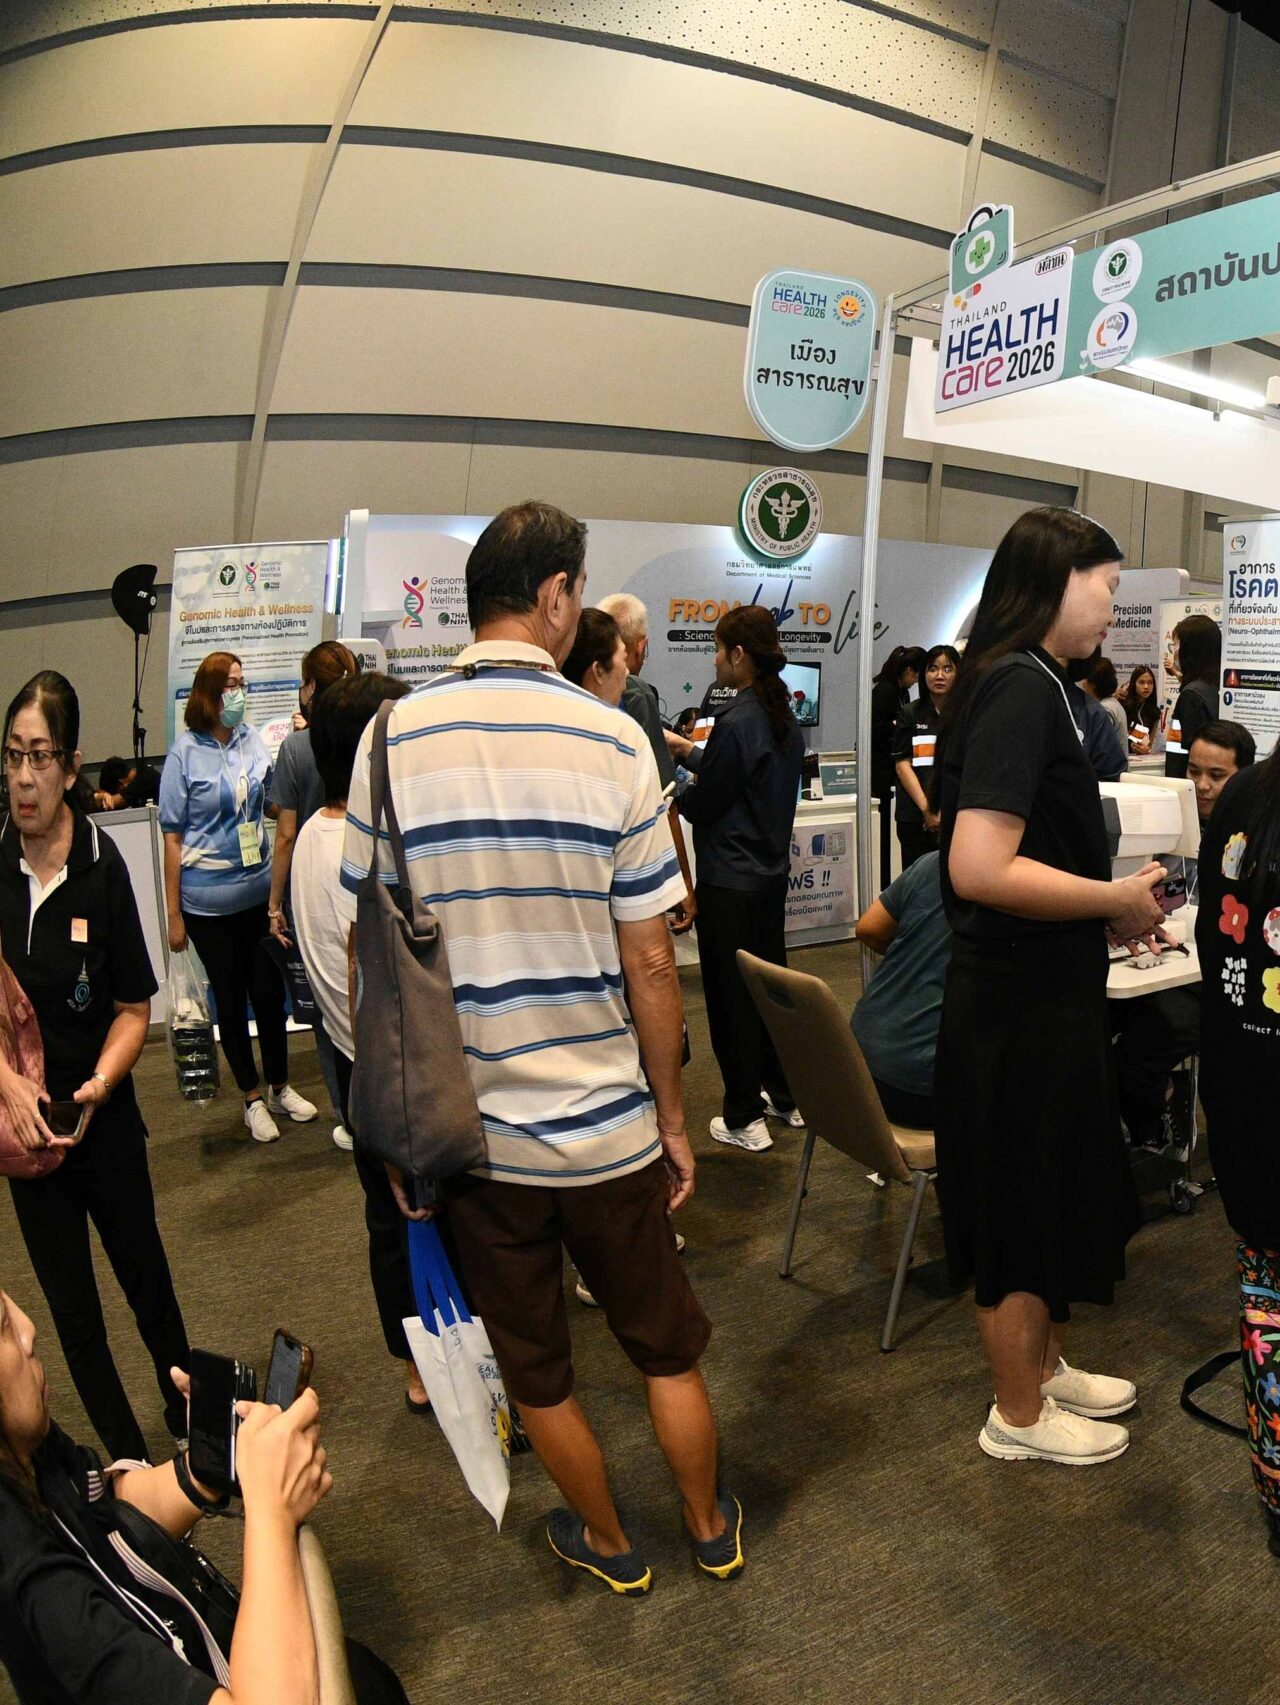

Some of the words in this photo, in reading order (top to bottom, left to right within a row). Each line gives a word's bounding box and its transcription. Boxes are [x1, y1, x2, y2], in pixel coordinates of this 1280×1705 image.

[773, 288, 827, 307] HEALTH
[772, 301, 802, 315] care
[804, 306, 826, 319] 2026
[951, 301, 1007, 329] THAILAND
[945, 298, 1059, 369] HEALTH
[791, 339, 836, 364] เมือง
[942, 356, 1004, 400] care
[1006, 341, 1055, 382] 2026
[756, 367, 864, 400] สาธารณสุข
[751, 518, 768, 544] MINISTRY
[779, 542, 800, 551] PUBLIC
[801, 521, 816, 544] HEALTH
[1240, 563, 1275, 574] อาการ
[431, 577, 466, 585] Genom
[180, 609, 222, 622] Genomic
[225, 607, 256, 618] Health
[268, 604, 313, 615] Wellness
[799, 603, 831, 624] TO
[1113, 604, 1152, 616] Precision
[1229, 600, 1278, 613] ที่เกี่ยวข้องกับ
[1113, 617, 1151, 629] Medicine
[685, 632, 715, 641] Scienc
[779, 633, 822, 643] Longevity
[385, 645, 430, 659] enomic
[785, 889, 844, 903] รทดสอบคุณภาพ
